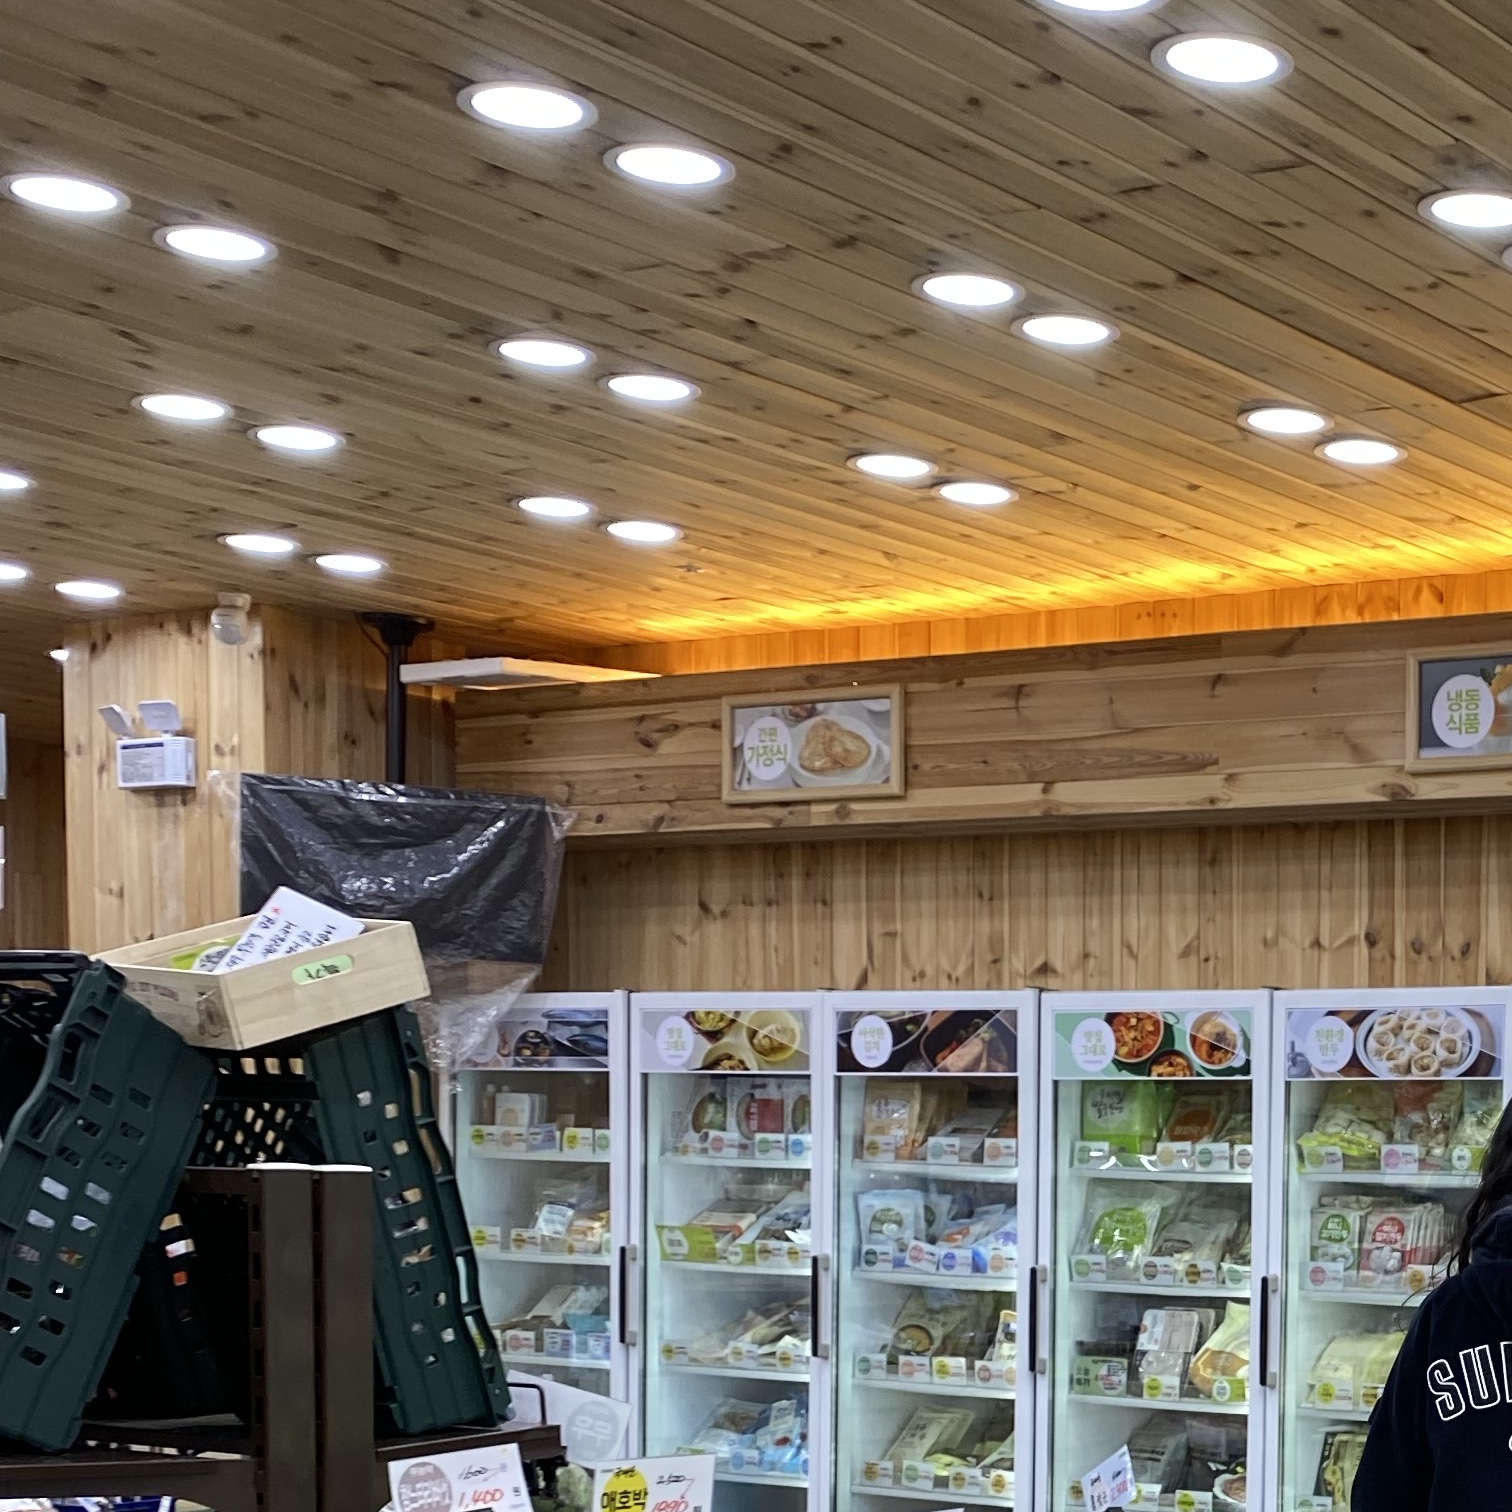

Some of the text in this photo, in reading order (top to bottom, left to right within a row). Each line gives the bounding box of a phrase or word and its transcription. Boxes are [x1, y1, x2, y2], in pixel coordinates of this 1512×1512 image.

[1446, 688, 1481, 712] 냉동
[757, 727, 778, 743] 간편
[1446, 712, 1480, 736] 식품
[747, 743, 788, 768] 가정식
[458, 1488, 504, 1510] 1,400
